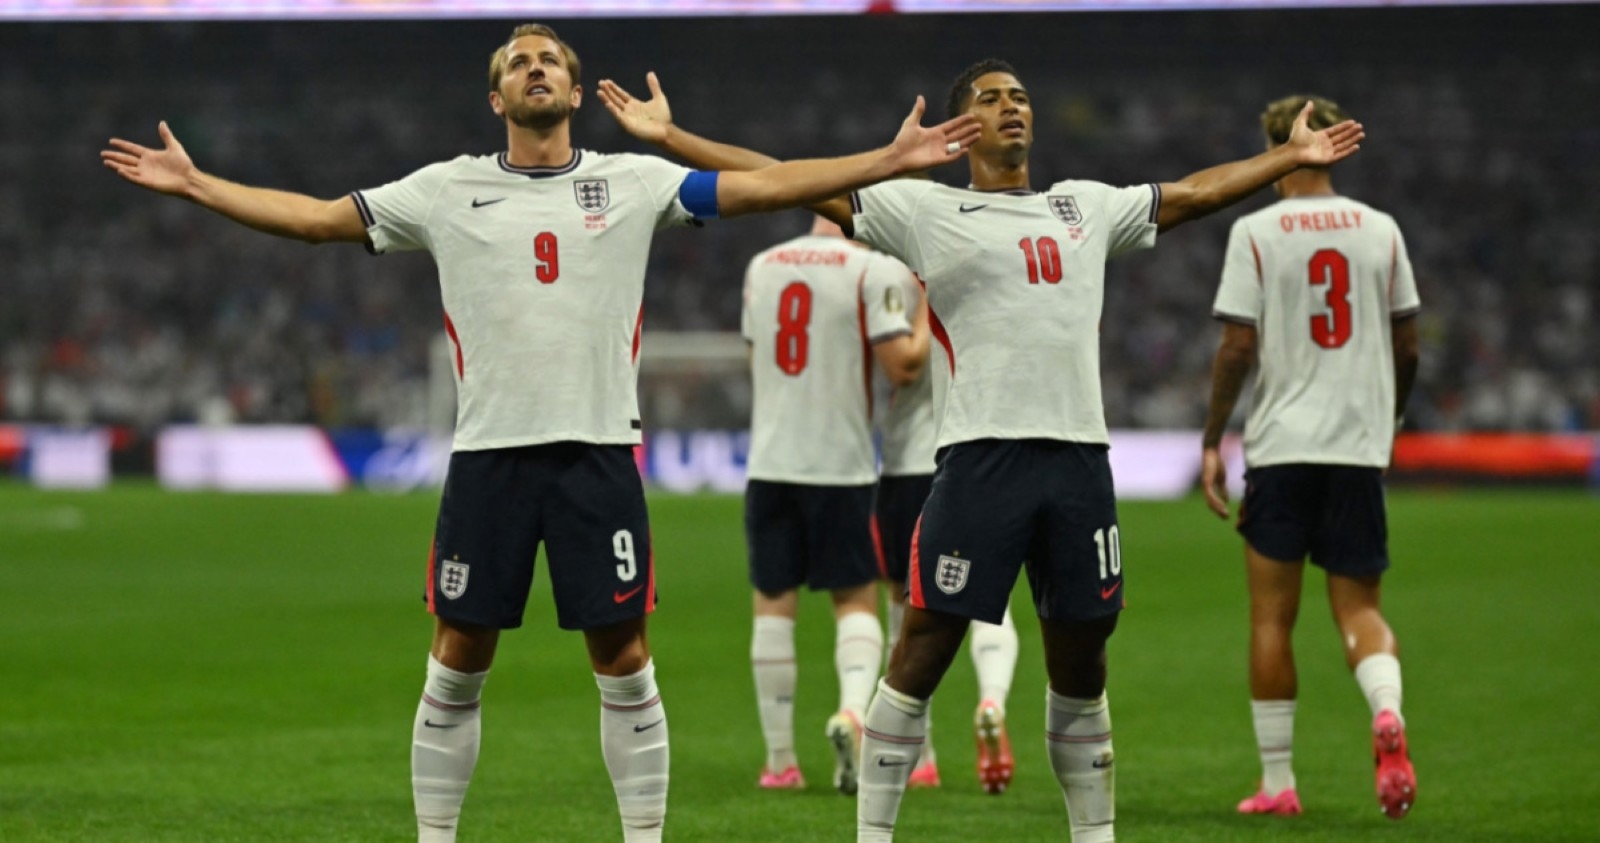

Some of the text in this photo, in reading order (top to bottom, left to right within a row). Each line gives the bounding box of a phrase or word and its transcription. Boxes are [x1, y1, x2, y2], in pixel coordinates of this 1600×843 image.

[1280, 210, 1363, 234] O'REILLY
[534, 231, 559, 284] 9
[1018, 236, 1063, 285] 10
[1308, 247, 1353, 350] 3
[775, 281, 813, 376] 8
[612, 529, 638, 582] 9
[1093, 524, 1122, 580] 10
